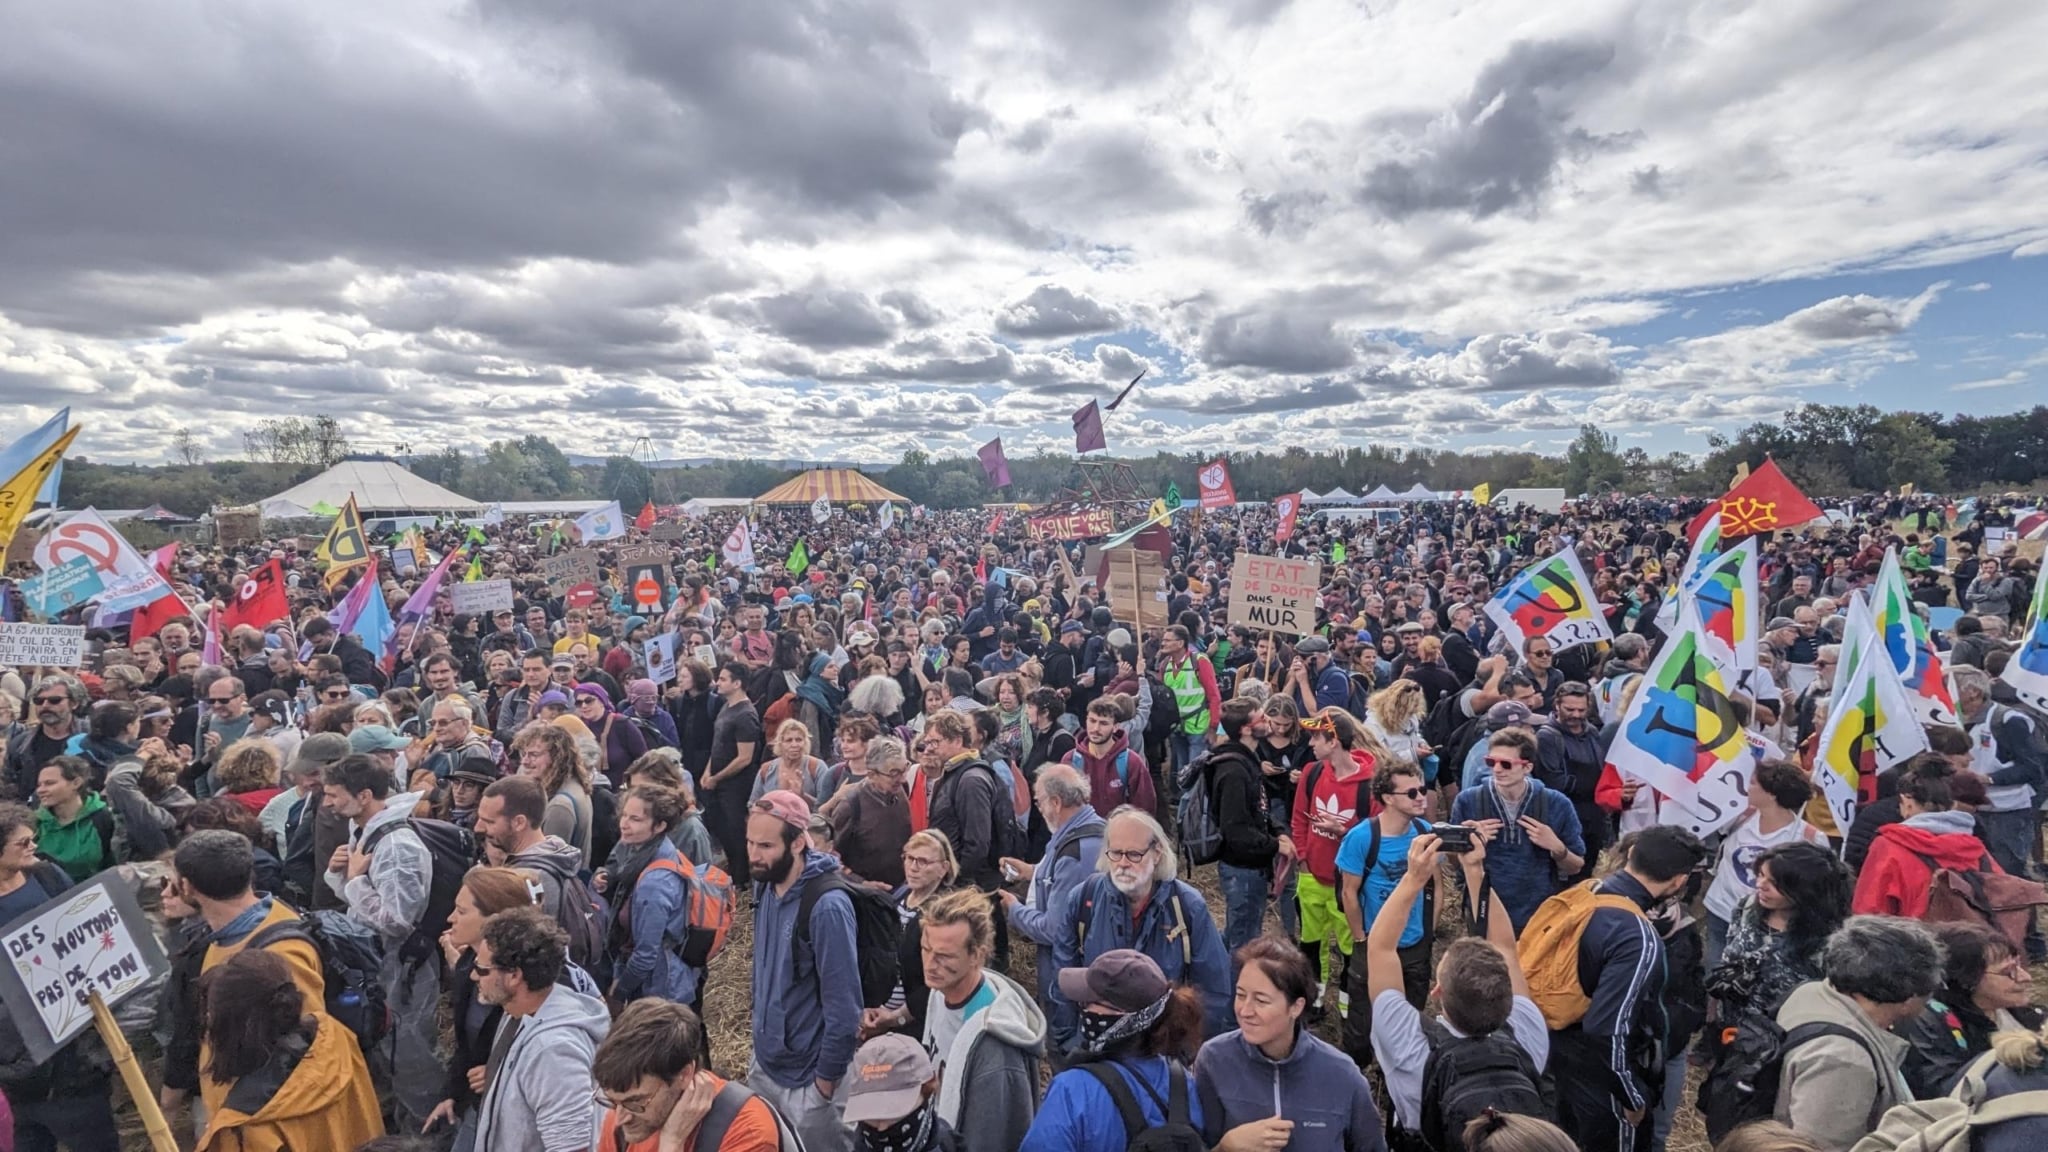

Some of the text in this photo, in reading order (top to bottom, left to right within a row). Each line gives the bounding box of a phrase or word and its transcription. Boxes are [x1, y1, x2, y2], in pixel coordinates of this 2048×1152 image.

[1087, 521, 1111, 536] PAS
[620, 547, 645, 561] STOP
[547, 557, 585, 573] FAITES
[1249, 560, 1306, 582] ETAT
[1244, 580, 1314, 599] DE DROIT
[1246, 594, 1298, 608] DANS LE
[1248, 605, 1298, 630] MUR
[30, 626, 84, 638] AUTOROUTE
[19, 636, 37, 646] CUL
[41, 636, 54, 646] DE
[59, 636, 79, 647] SAC
[22, 645, 57, 655] FINIRA
[62, 646, 78, 656] EN
[40, 655, 73, 665] QUEUE
[8, 905, 120, 961] DES MOUTONS
[36, 963, 86, 1009] PAS DE
